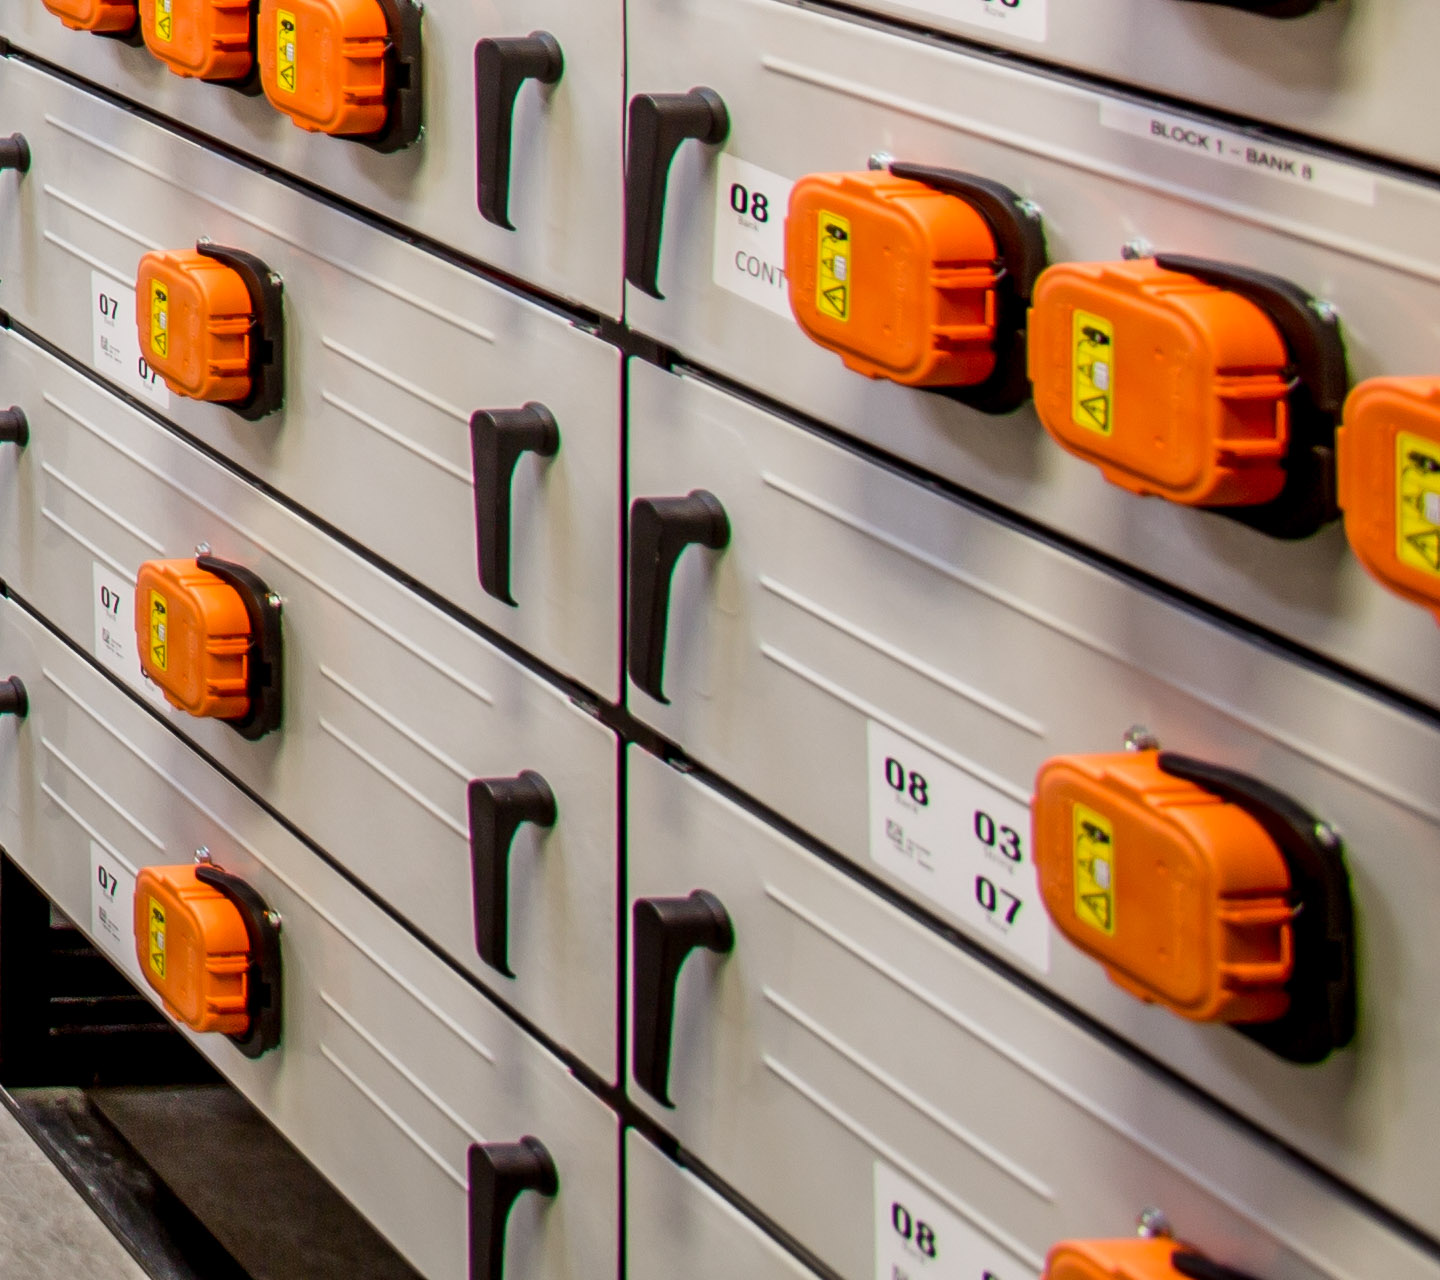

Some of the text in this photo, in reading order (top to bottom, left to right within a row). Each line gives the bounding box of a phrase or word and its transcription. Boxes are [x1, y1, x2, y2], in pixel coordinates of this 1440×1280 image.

[1150, 120, 1209, 149] BLOCK
[1216, 139, 1222, 152] 1
[1246, 148, 1295, 174] BANK
[1302, 164, 1313, 180] 8
[730, 183, 769, 223] 08
[99, 293, 118, 320] 07
[101, 585, 120, 614] 07
[885, 757, 929, 807] 08
[974, 810, 1022, 863] 03
[98, 865, 118, 897] 07
[975, 875, 1022, 925] 07
[891, 1202, 937, 1259] 08
